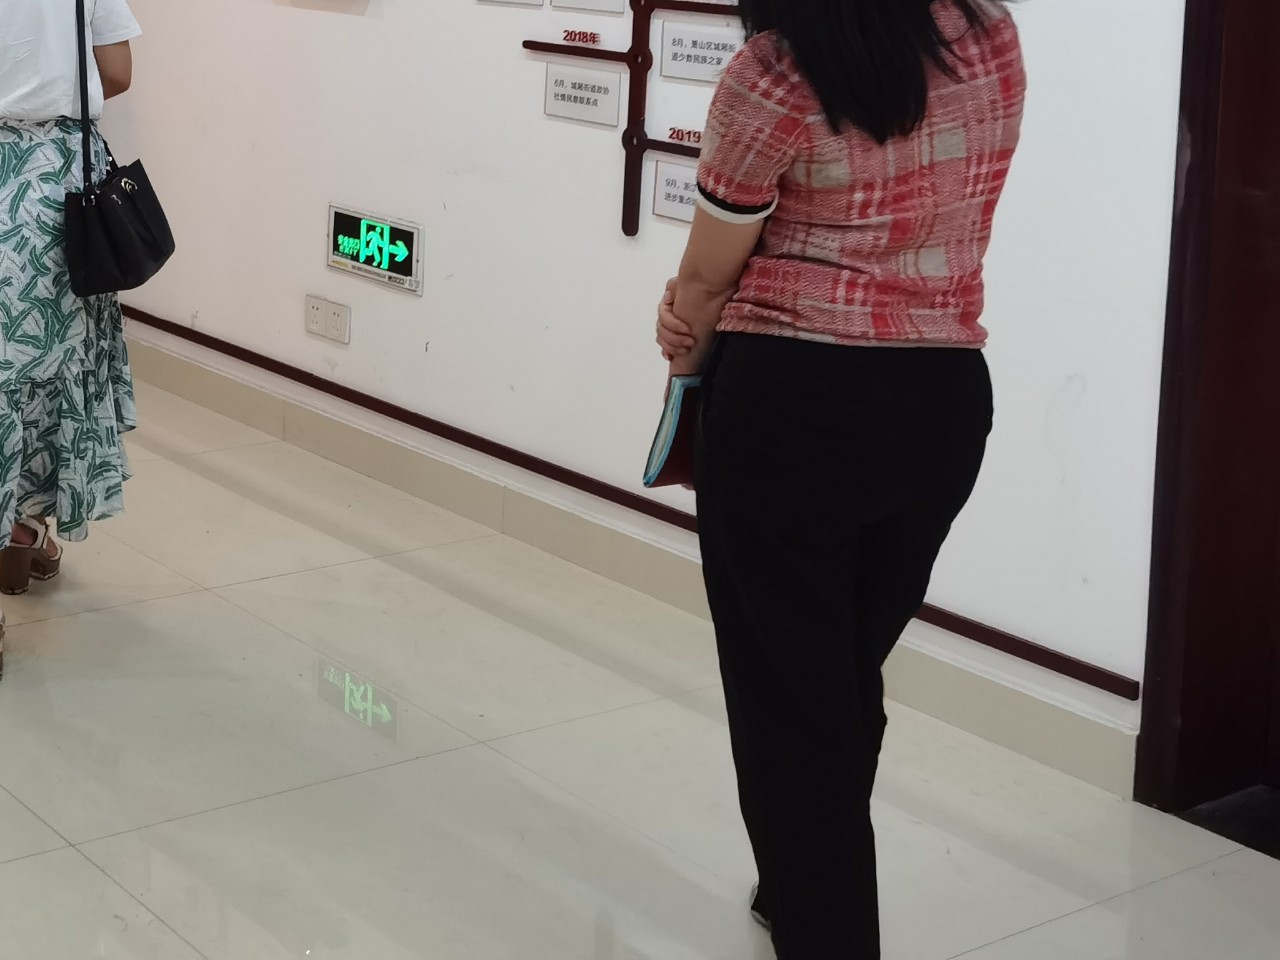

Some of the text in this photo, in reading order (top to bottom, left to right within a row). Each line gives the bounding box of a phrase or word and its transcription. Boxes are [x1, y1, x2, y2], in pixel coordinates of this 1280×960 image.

[562, 29, 601, 45] 2018年
[671, 37, 737, 53] 8月，萧山区城厢街
[671, 52, 724, 65] 道少数民族之家
[554, 91, 599, 107] 社情民意联系点
[339, 245, 358, 256] EXIT
